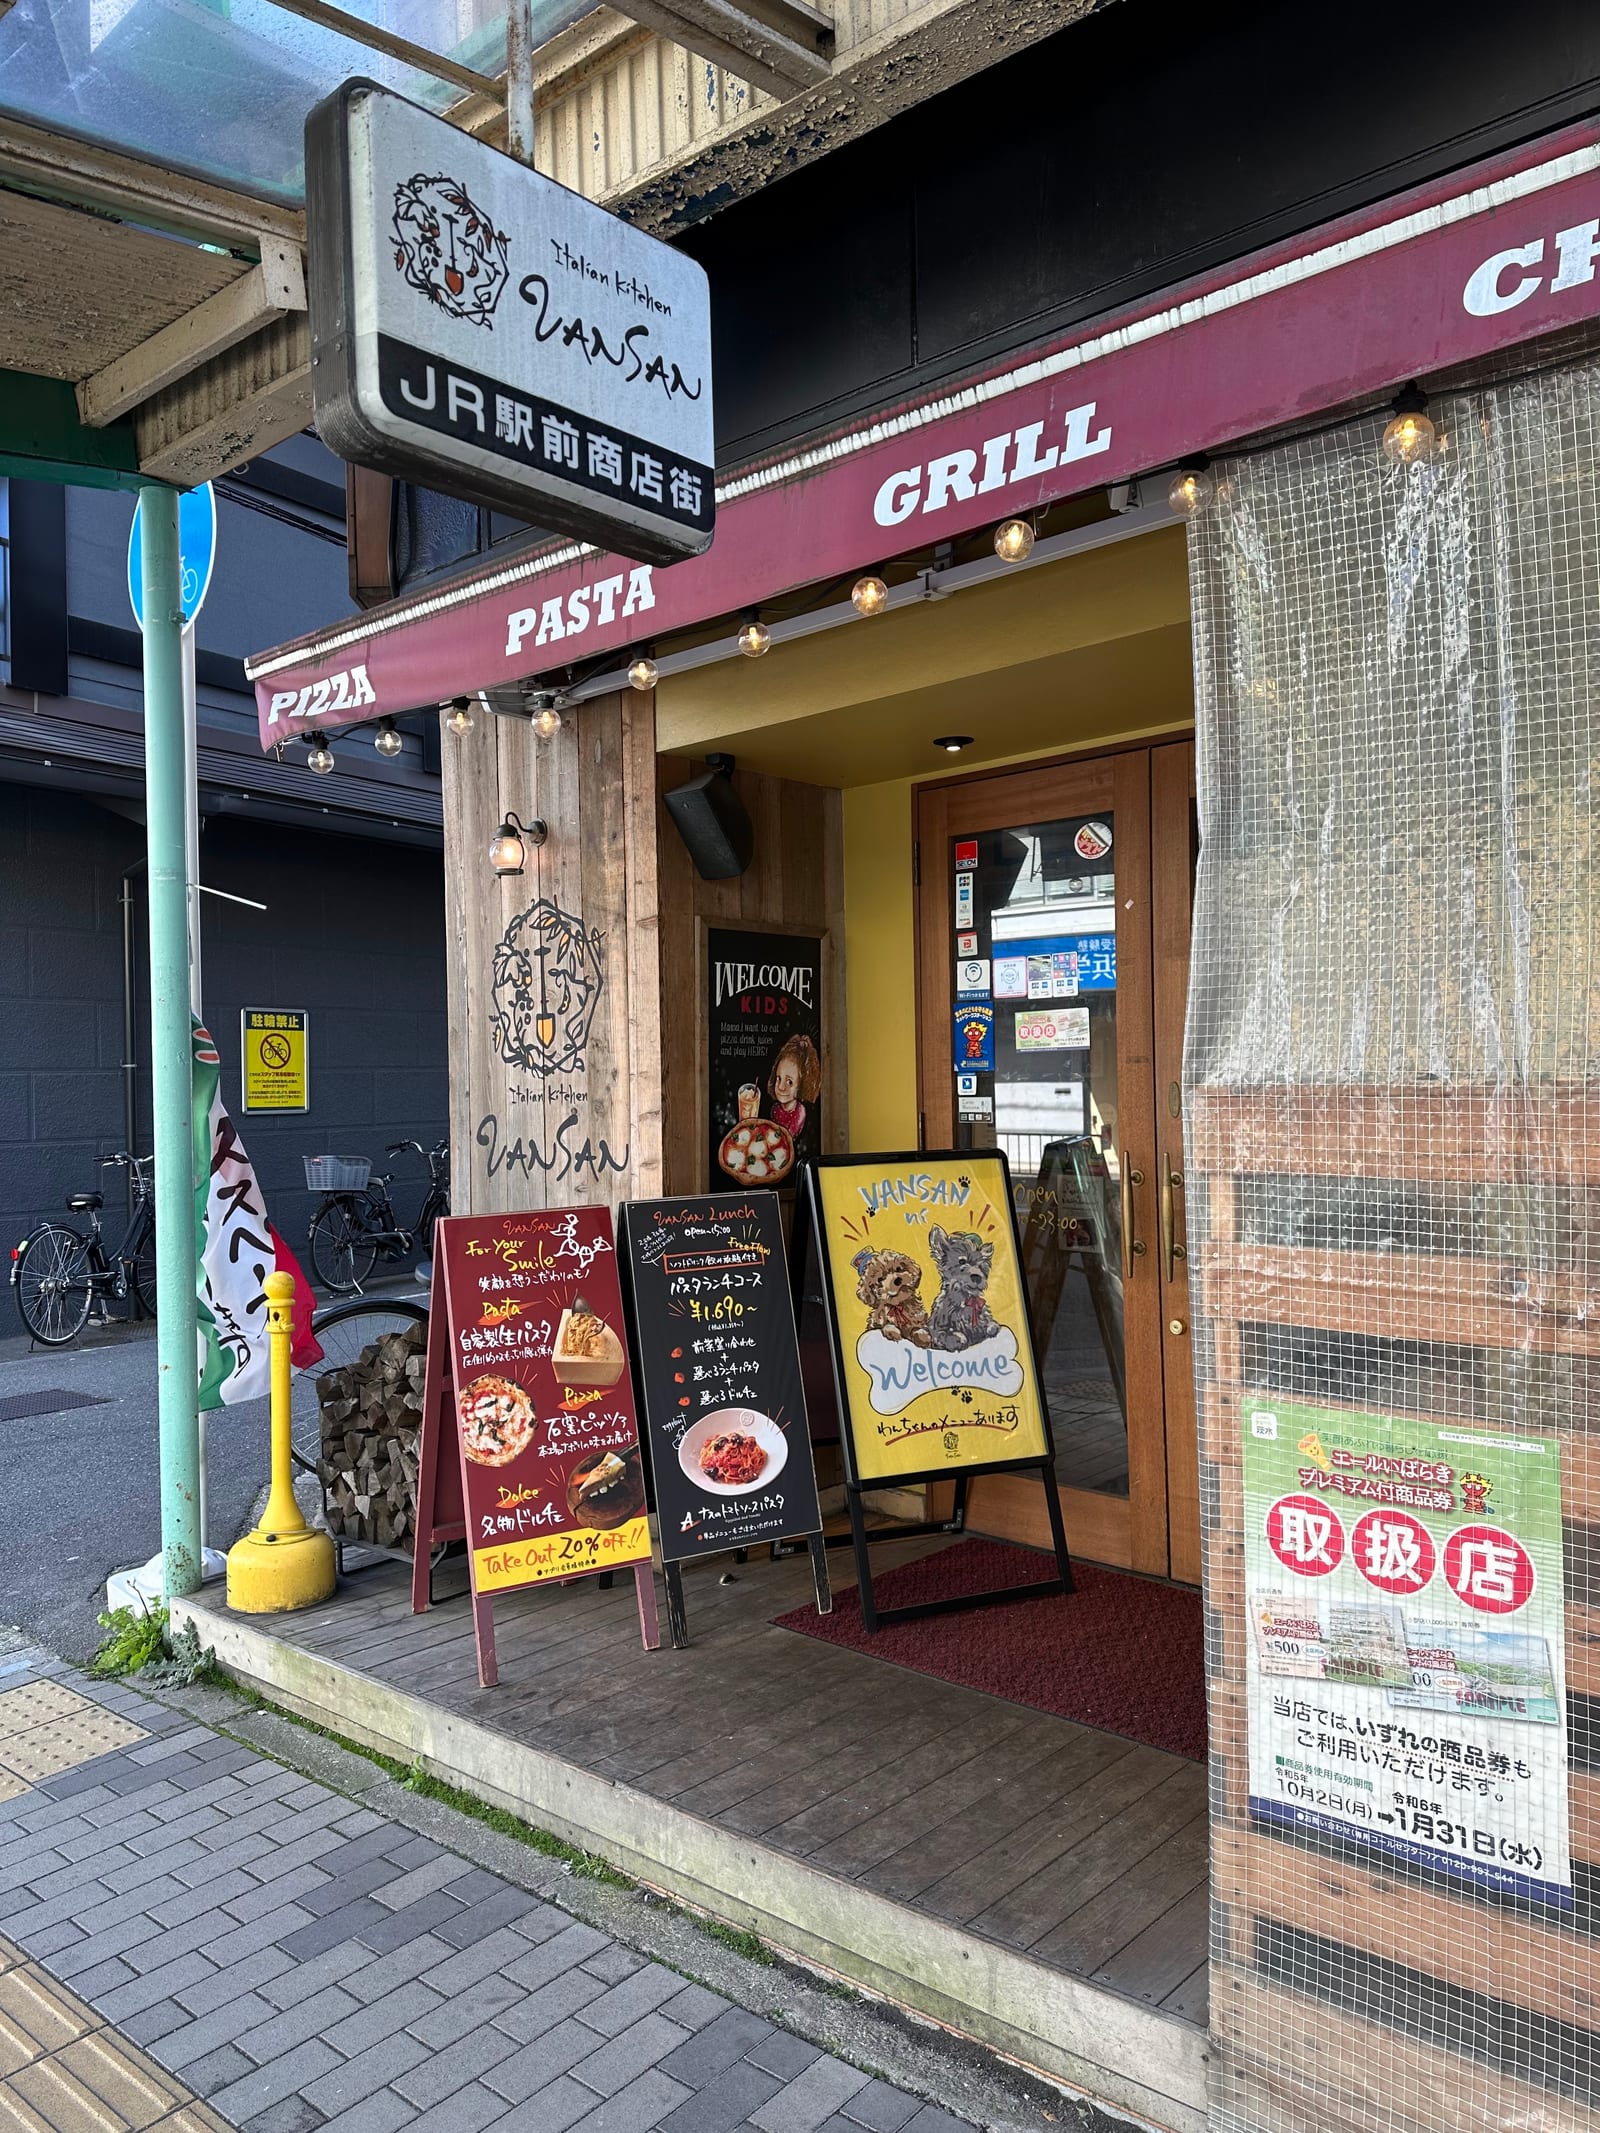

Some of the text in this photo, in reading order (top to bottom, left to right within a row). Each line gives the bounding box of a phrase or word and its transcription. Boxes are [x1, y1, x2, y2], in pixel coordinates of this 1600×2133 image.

[550, 238, 609, 286] Italian
[400, 365, 703, 517] JR駅前商店街
[872, 402, 1113, 527] GRILL
[505, 565, 657, 656] PASTA
[267, 664, 376, 726] PIZZA
[714, 961, 814, 1009] WELCOME
[251, 1013, 299, 1029] 駐輪禁止
[740, 995, 789, 1016] KIDS
[509, 1086, 545, 1105] Italian
[859, 1174, 971, 1211] VANSAN
[709, 1204, 758, 1222] Lunch
[465, 1240, 491, 1257] For
[502, 1240, 557, 1272] Smile
[670, 1272, 763, 1295] パスタランチコース
[482, 1297, 523, 1320] Pasta
[460, 1319, 552, 1351] 自家製生パスタ
[869, 1348, 1014, 1391] Welcome
[564, 1386, 603, 1406] Pizza
[700, 1384, 758, 1406] 選べるドルチェ
[1332, 1450, 1453, 1483] エールいばらき
[498, 1483, 540, 1505] Dolce
[1300, 1466, 1454, 1508] プレミアム付商品券
[680, 1511, 694, 1531] A
[482, 1554, 521, 1575] Take
[525, 1543, 558, 1567] Out
[558, 1533, 601, 1560] 20%
[1273, 1695, 1532, 1780] 当店では、いずれの商品券も
[1274, 1766, 1309, 1783] 令和5年
[1297, 1728, 1504, 1803] ご利用いただけます。
[1278, 1778, 1372, 1821] 10月2日(月)
[1391, 1791, 1443, 1815] 令和6年
[1395, 1808, 1543, 1870] 1月31日(水)
